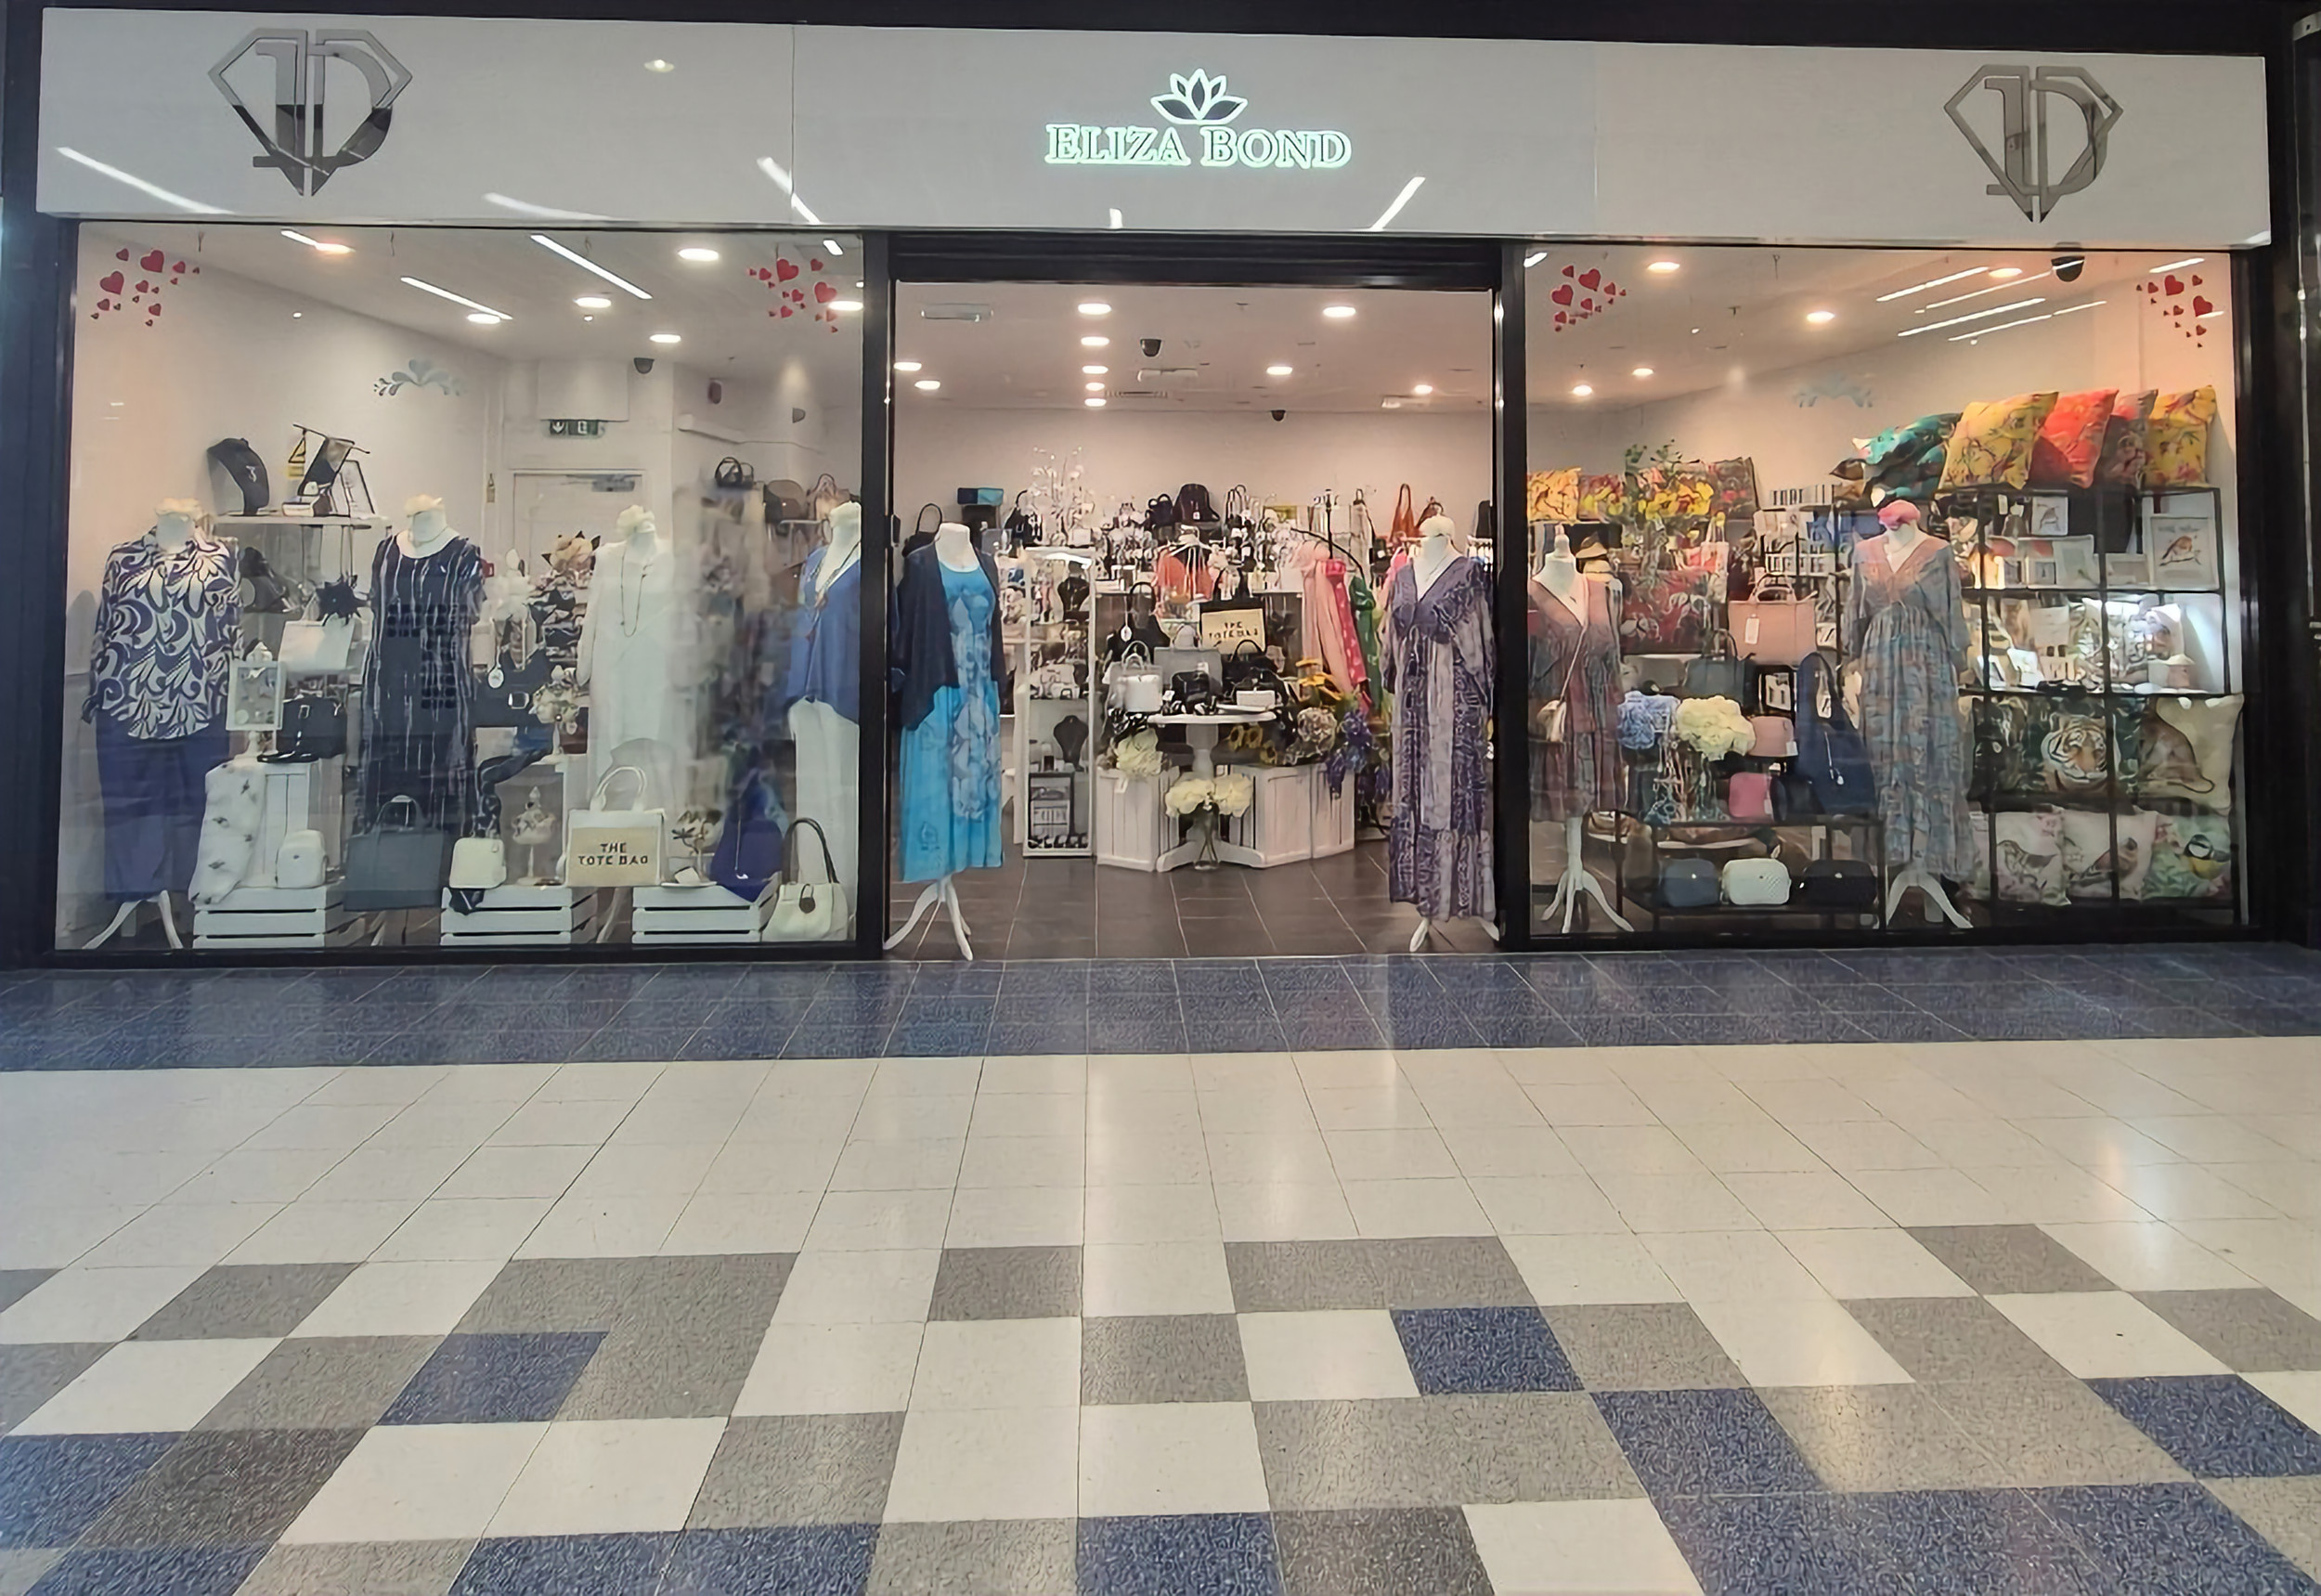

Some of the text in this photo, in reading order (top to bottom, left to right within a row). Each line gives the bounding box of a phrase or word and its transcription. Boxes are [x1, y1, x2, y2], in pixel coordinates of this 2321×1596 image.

[1045, 124, 1352, 168] ELIZA BOND
[600, 842, 627, 853] THE
[578, 855, 613, 865] TOTE
